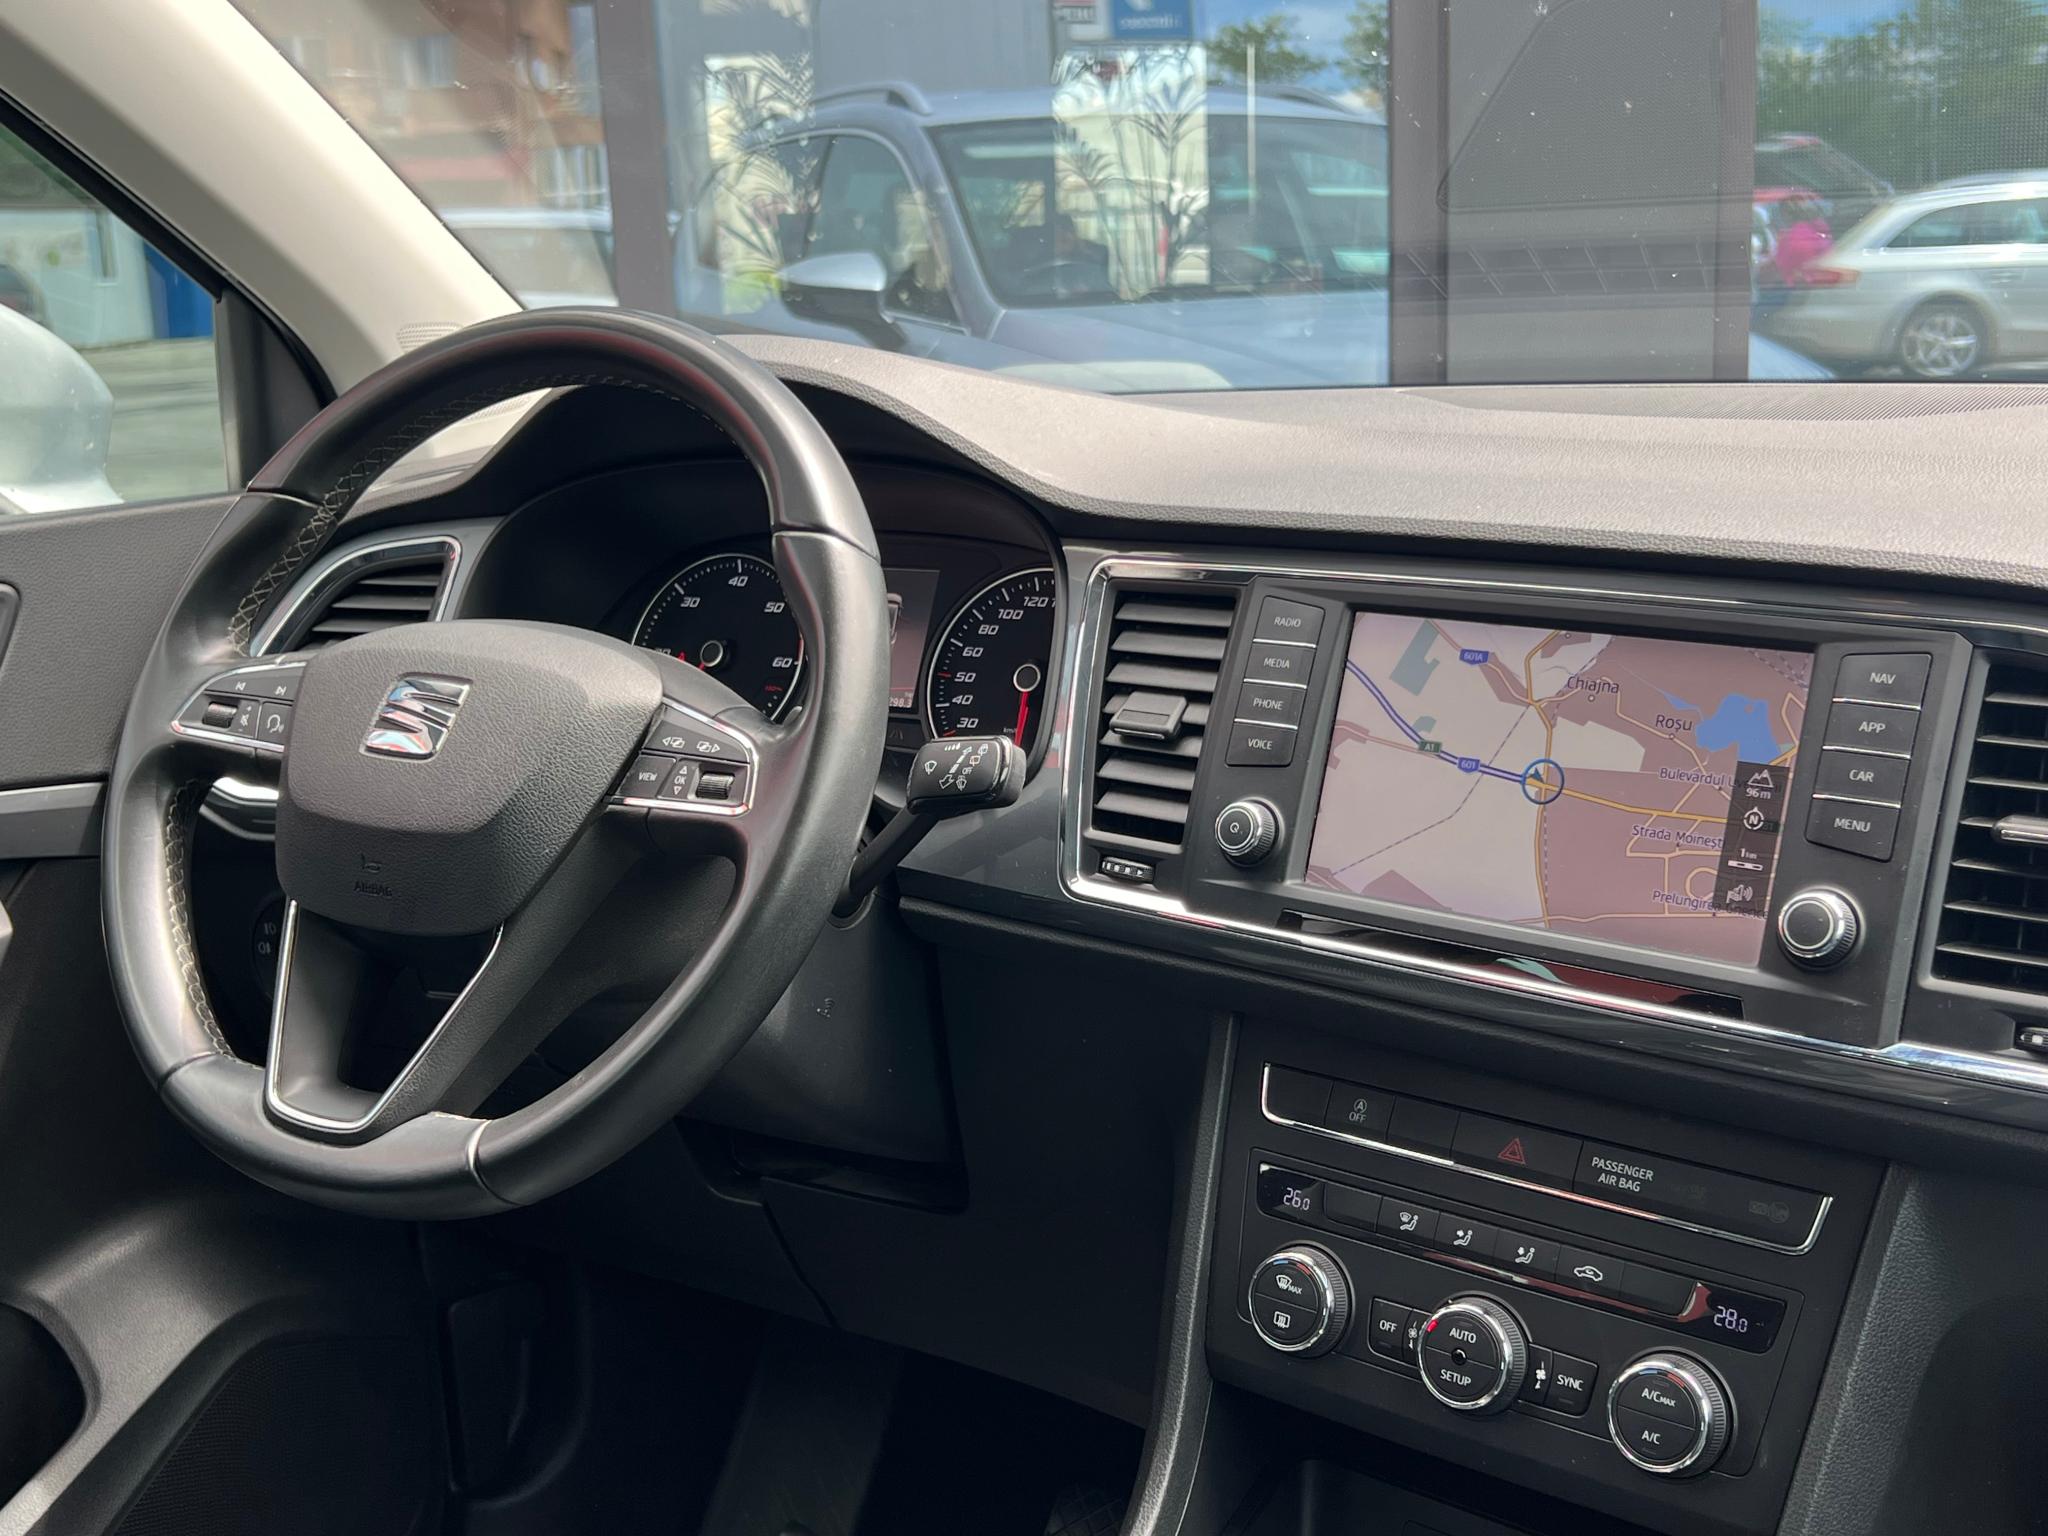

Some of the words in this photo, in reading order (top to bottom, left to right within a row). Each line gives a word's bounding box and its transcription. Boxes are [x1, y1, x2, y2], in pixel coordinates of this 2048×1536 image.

[728, 576, 748, 587] 40
[680, 597, 700, 608] 30
[764, 602, 785, 613] 50
[1023, 596, 1048, 608] 120
[998, 609, 1024, 620] 100
[1274, 616, 1301, 627] RADIO
[978, 624, 999, 635] 80
[962, 647, 983, 658] 60
[1463, 651, 1483, 662] 601A
[772, 657, 792, 668] 60
[1264, 657, 1290, 669] MEDIA
[954, 672, 976, 683] 50
[1869, 672, 1896, 684] NAV
[1567, 675, 1620, 694] Chiajna
[952, 694, 973, 705] 40
[1253, 697, 1284, 711] PHONE
[956, 717, 979, 729] 30
[1655, 714, 1693, 732] Roșu
[1858, 721, 1886, 734] APP
[1248, 738, 1273, 750] VOICE
[1461, 760, 1476, 769] 601
[638, 772, 658, 782] VIEW
[674, 775, 686, 785] OK
[1659, 767, 1725, 787] Bulevardul
[1849, 769, 1874, 783] CAR
[1834, 817, 1871, 833] MENU
[1632, 824, 1671, 841] Strada
[1349, 1111, 1367, 1124] OFF
[1591, 1156, 1654, 1182] PASSENGER
[1597, 1172, 1617, 1187] AIR
[1618, 1176, 1641, 1193] BAG
[1288, 1284, 1302, 1295] MAX
[1379, 1319, 1398, 1333] OFF
[1449, 1326, 1477, 1344] AUTO
[1440, 1368, 1472, 1387] SETUP
[1556, 1373, 1584, 1392] SYNC
[1641, 1430, 1661, 1445] A/C
